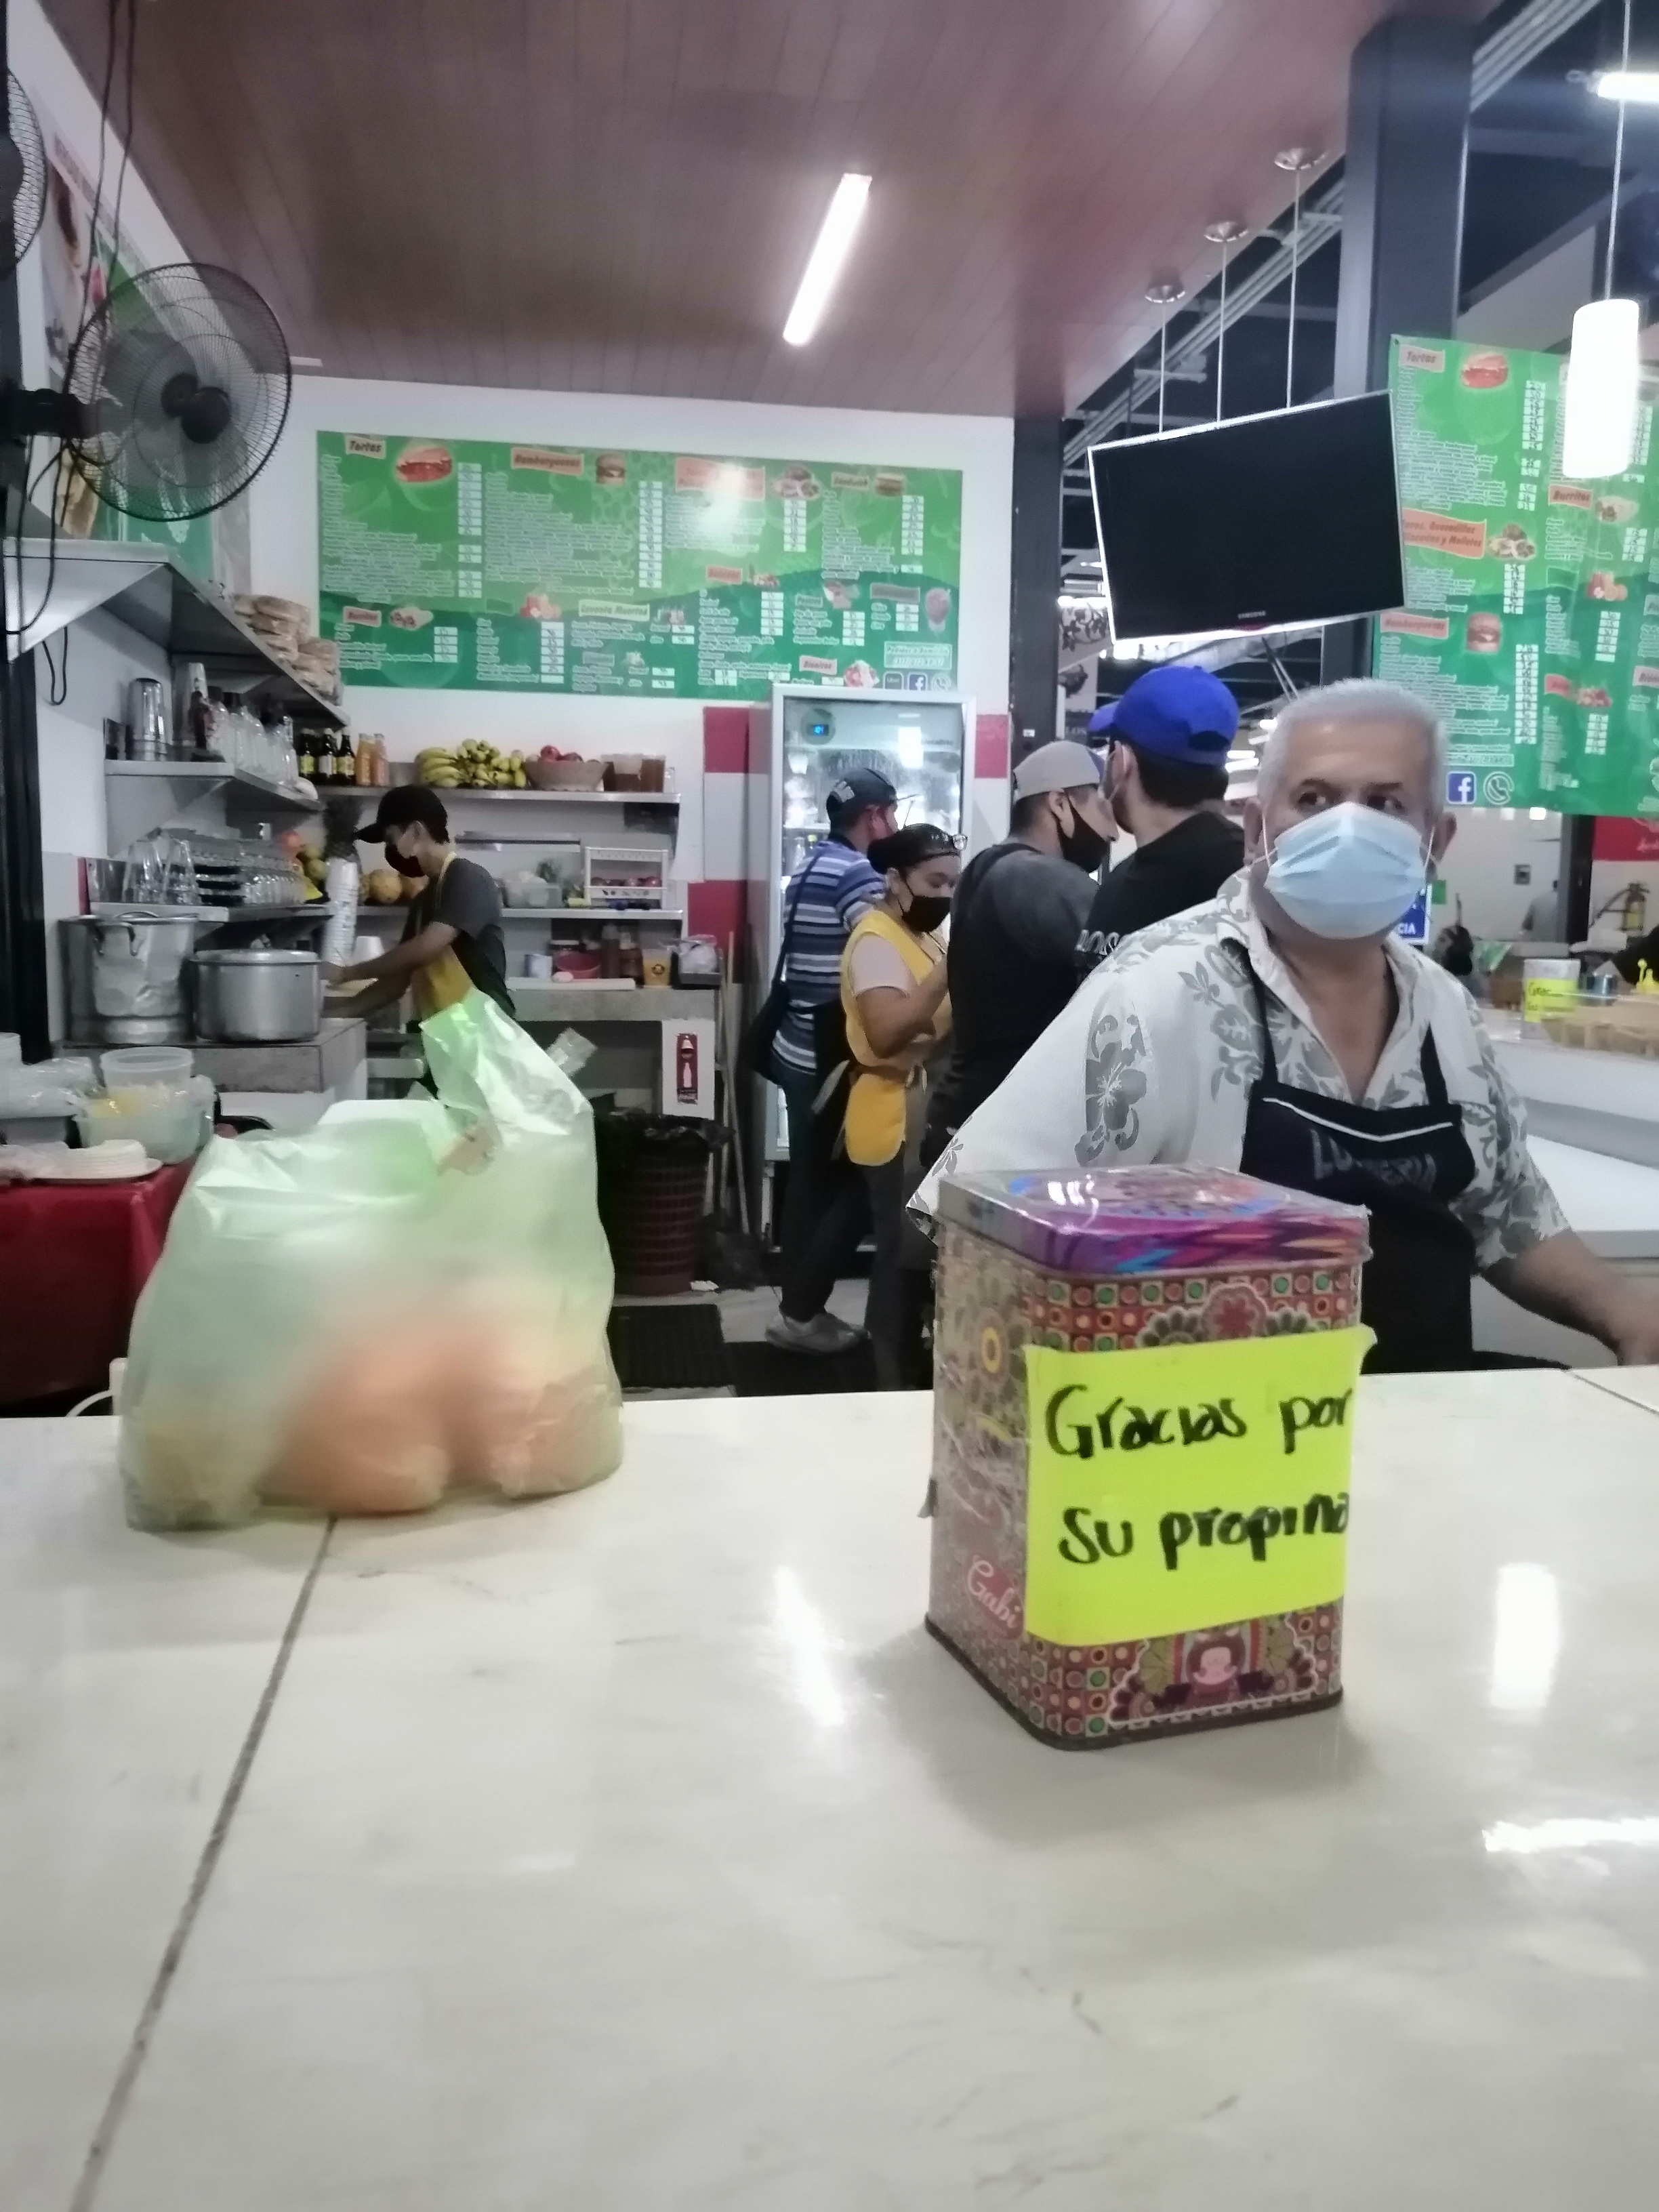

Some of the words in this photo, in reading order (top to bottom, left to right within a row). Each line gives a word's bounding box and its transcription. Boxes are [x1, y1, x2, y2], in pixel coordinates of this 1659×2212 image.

[349, 440, 382, 453] Tortas
[1044, 1383, 1248, 1459] Gracias
[1279, 1388, 1353, 1455] por
[1158, 1492, 1350, 1572] propina
[967, 1554, 1021, 1629] Gabi
